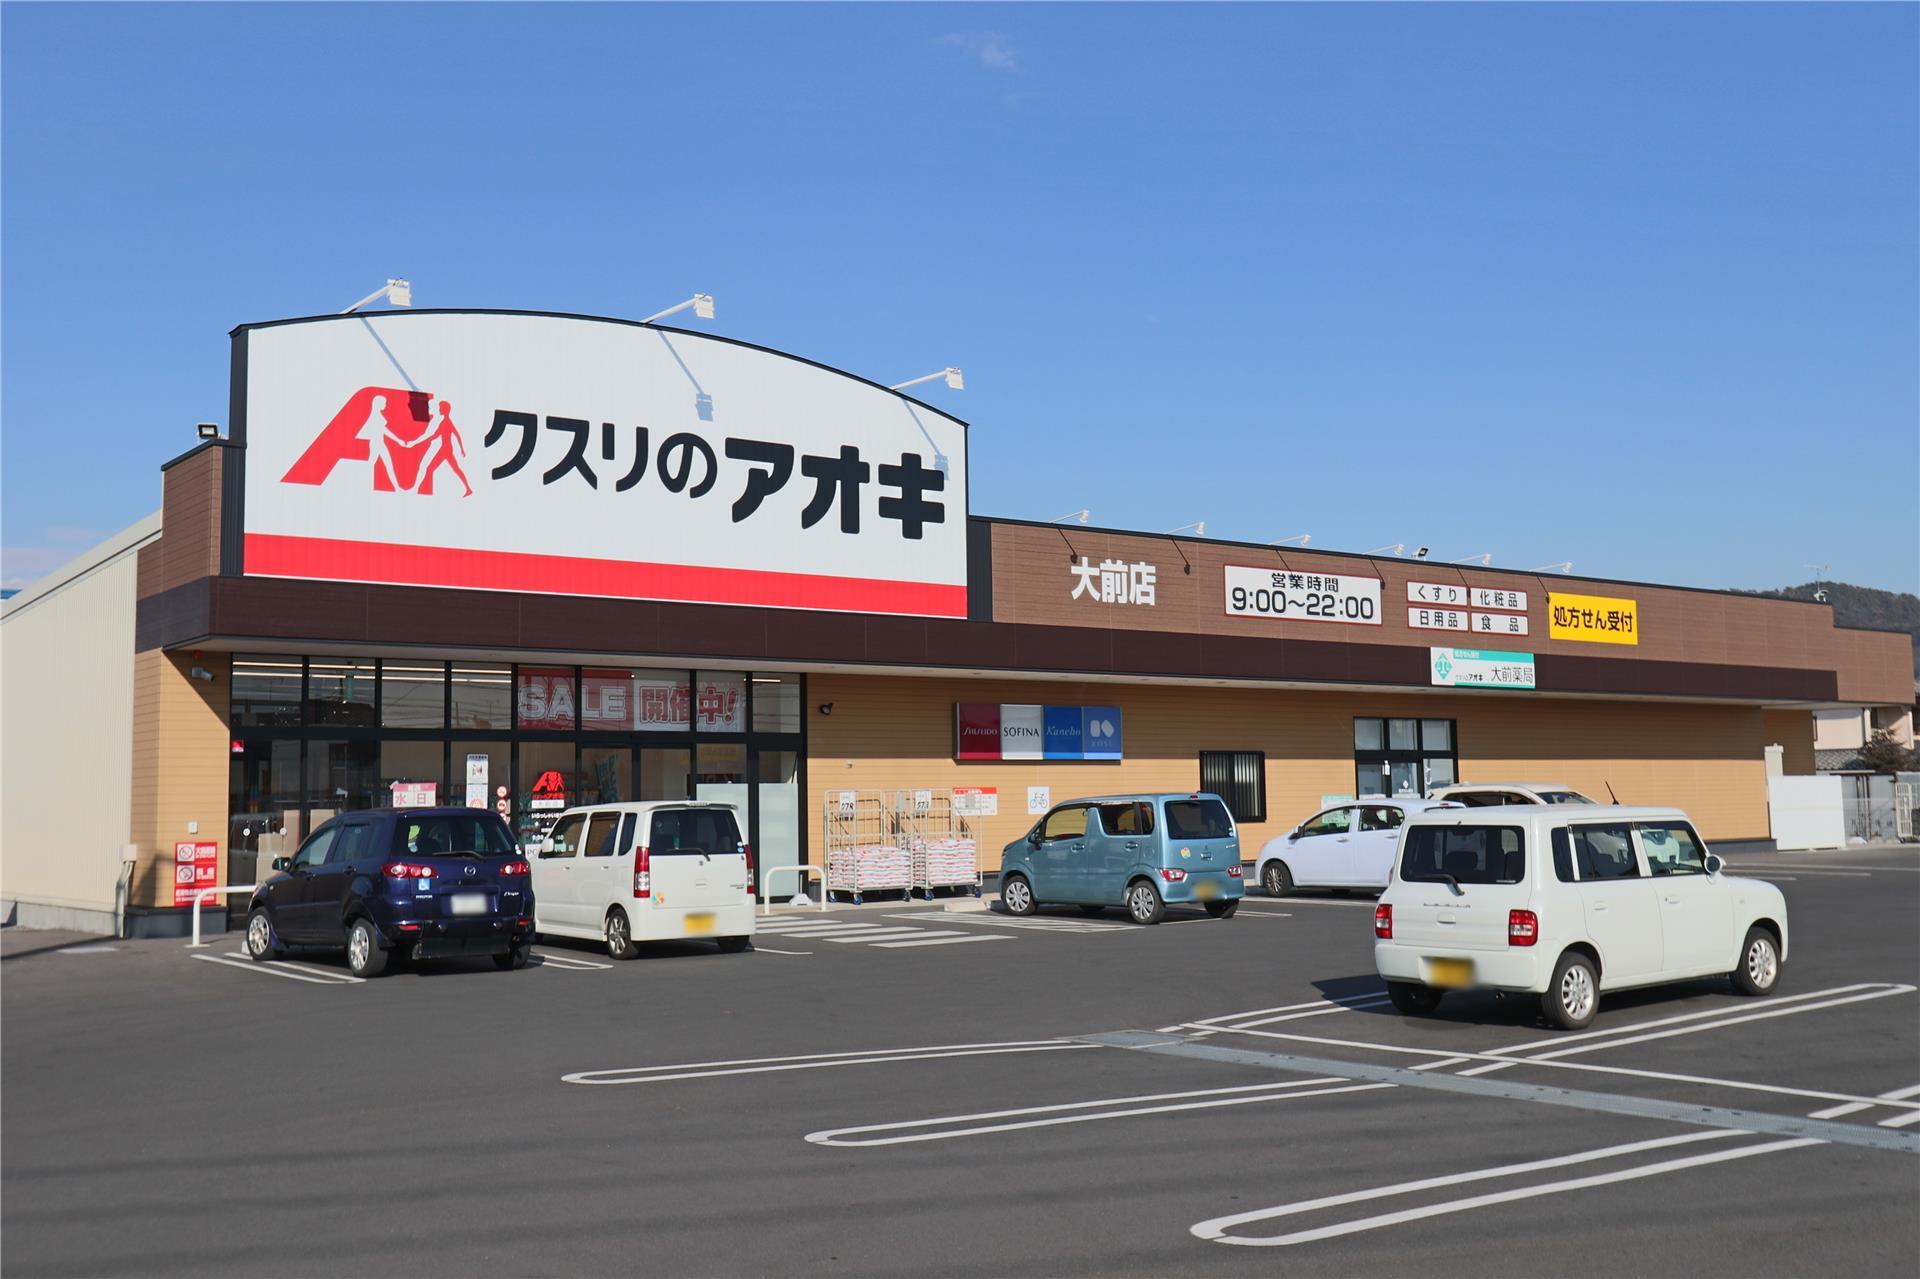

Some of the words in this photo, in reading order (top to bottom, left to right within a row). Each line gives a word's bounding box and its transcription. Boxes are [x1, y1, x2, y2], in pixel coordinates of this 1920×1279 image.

[484, 409, 945, 540] クスリのアオキ
[1071, 557, 1157, 606] 大前店
[1271, 573, 1339, 593] 営業時間
[1418, 585, 1457, 602] くすり
[1480, 591, 1518, 608] 化粧品
[1420, 610, 1458, 628] 日用品
[1553, 606, 1633, 633] 処方せん受付
[1491, 666, 1533, 684] 大前薬局
[518, 683, 626, 721] SALE
[1003, 726, 1040, 738] SOFINA
[1046, 725, 1081, 737] Kanebo
